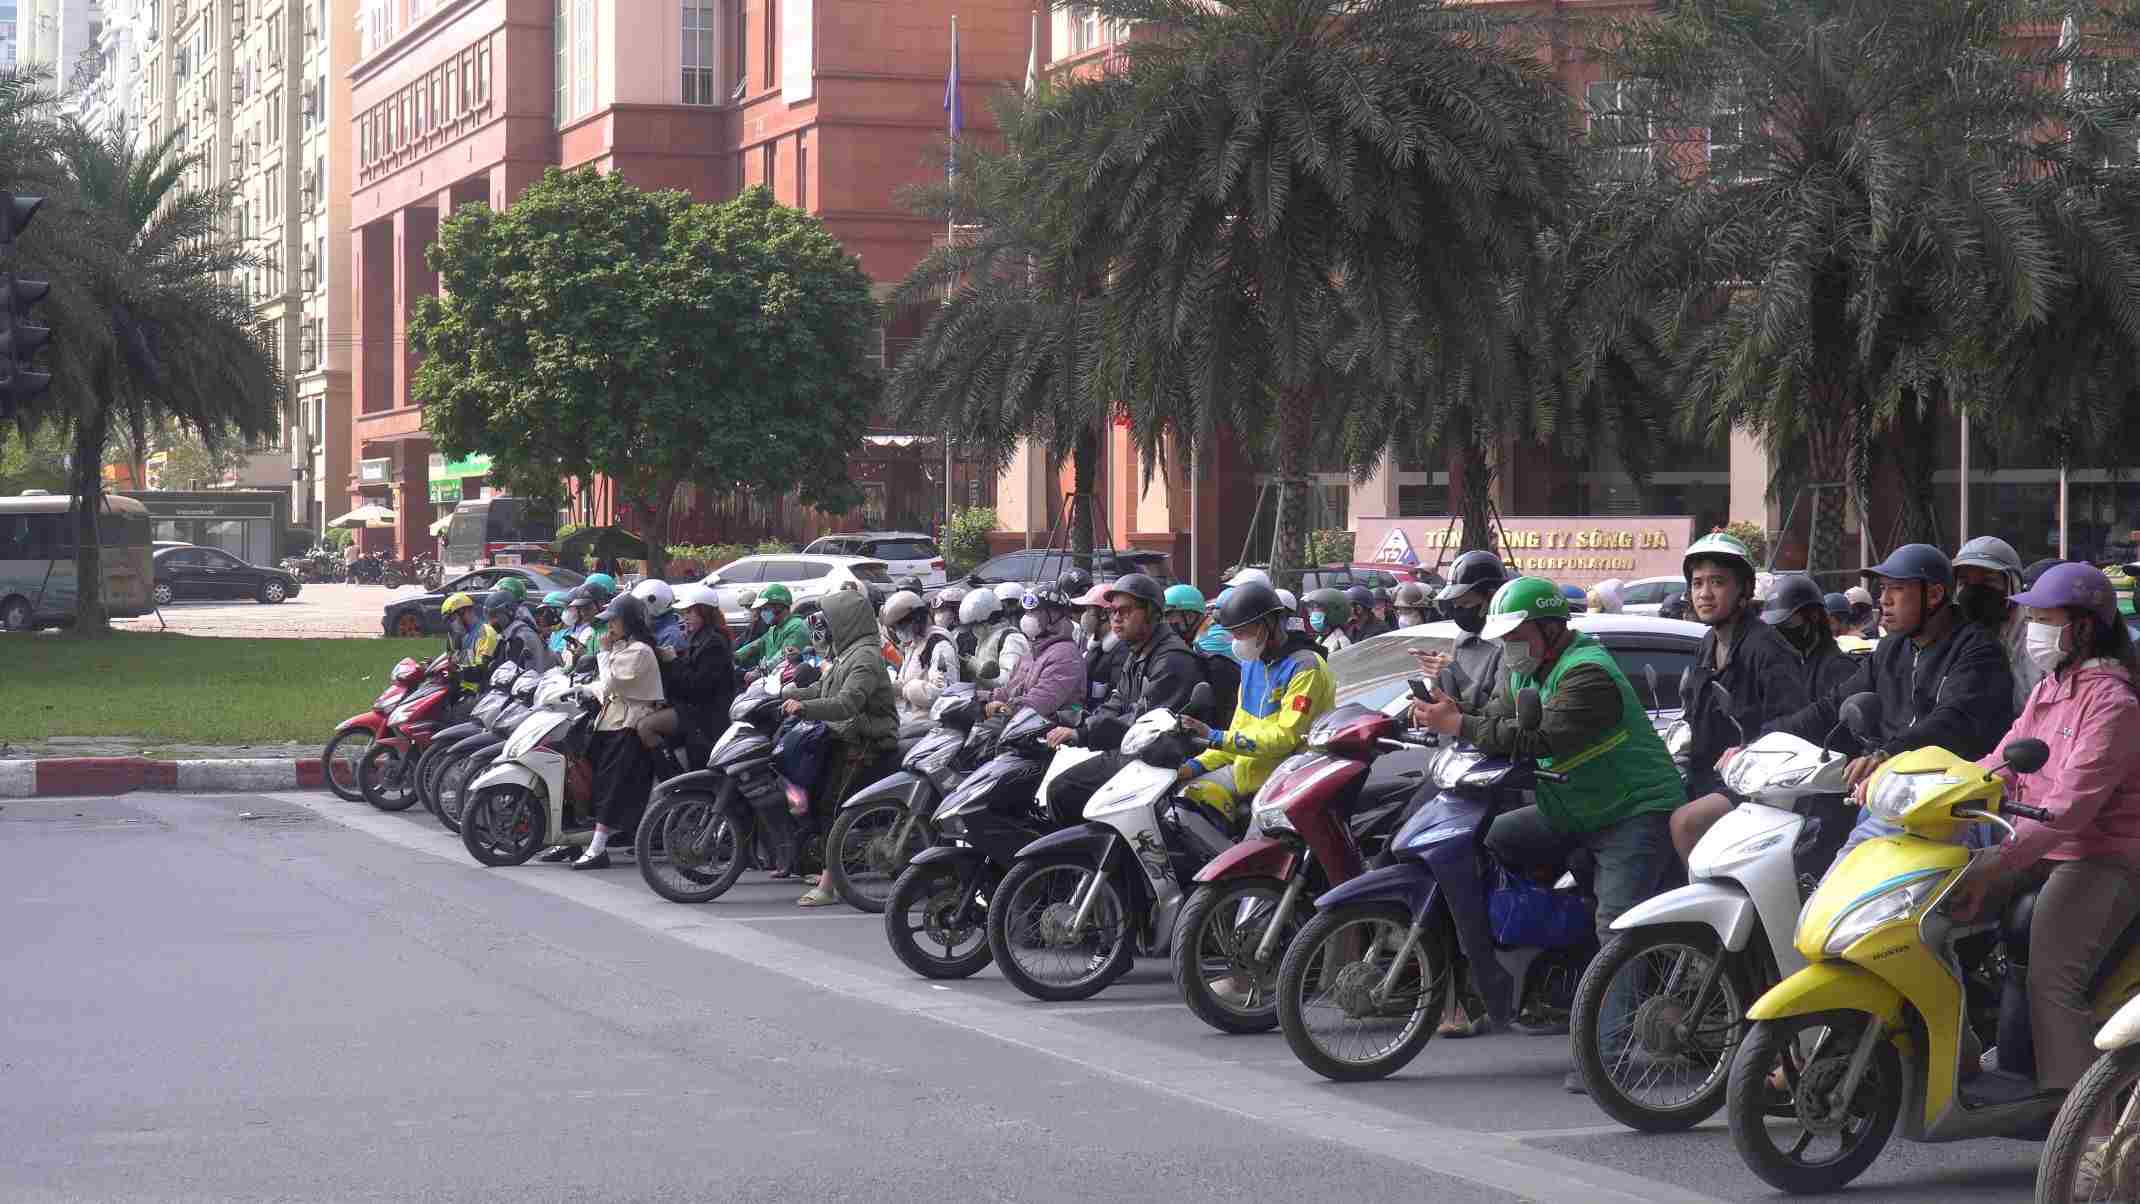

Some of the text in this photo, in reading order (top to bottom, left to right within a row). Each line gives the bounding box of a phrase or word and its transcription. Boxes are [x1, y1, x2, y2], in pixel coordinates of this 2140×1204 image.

[1547, 531, 1571, 549] TY
[1527, 558, 1636, 570] CORPORATION
[1535, 594, 1565, 609] Grab
[1871, 944, 1911, 961] HONDA
